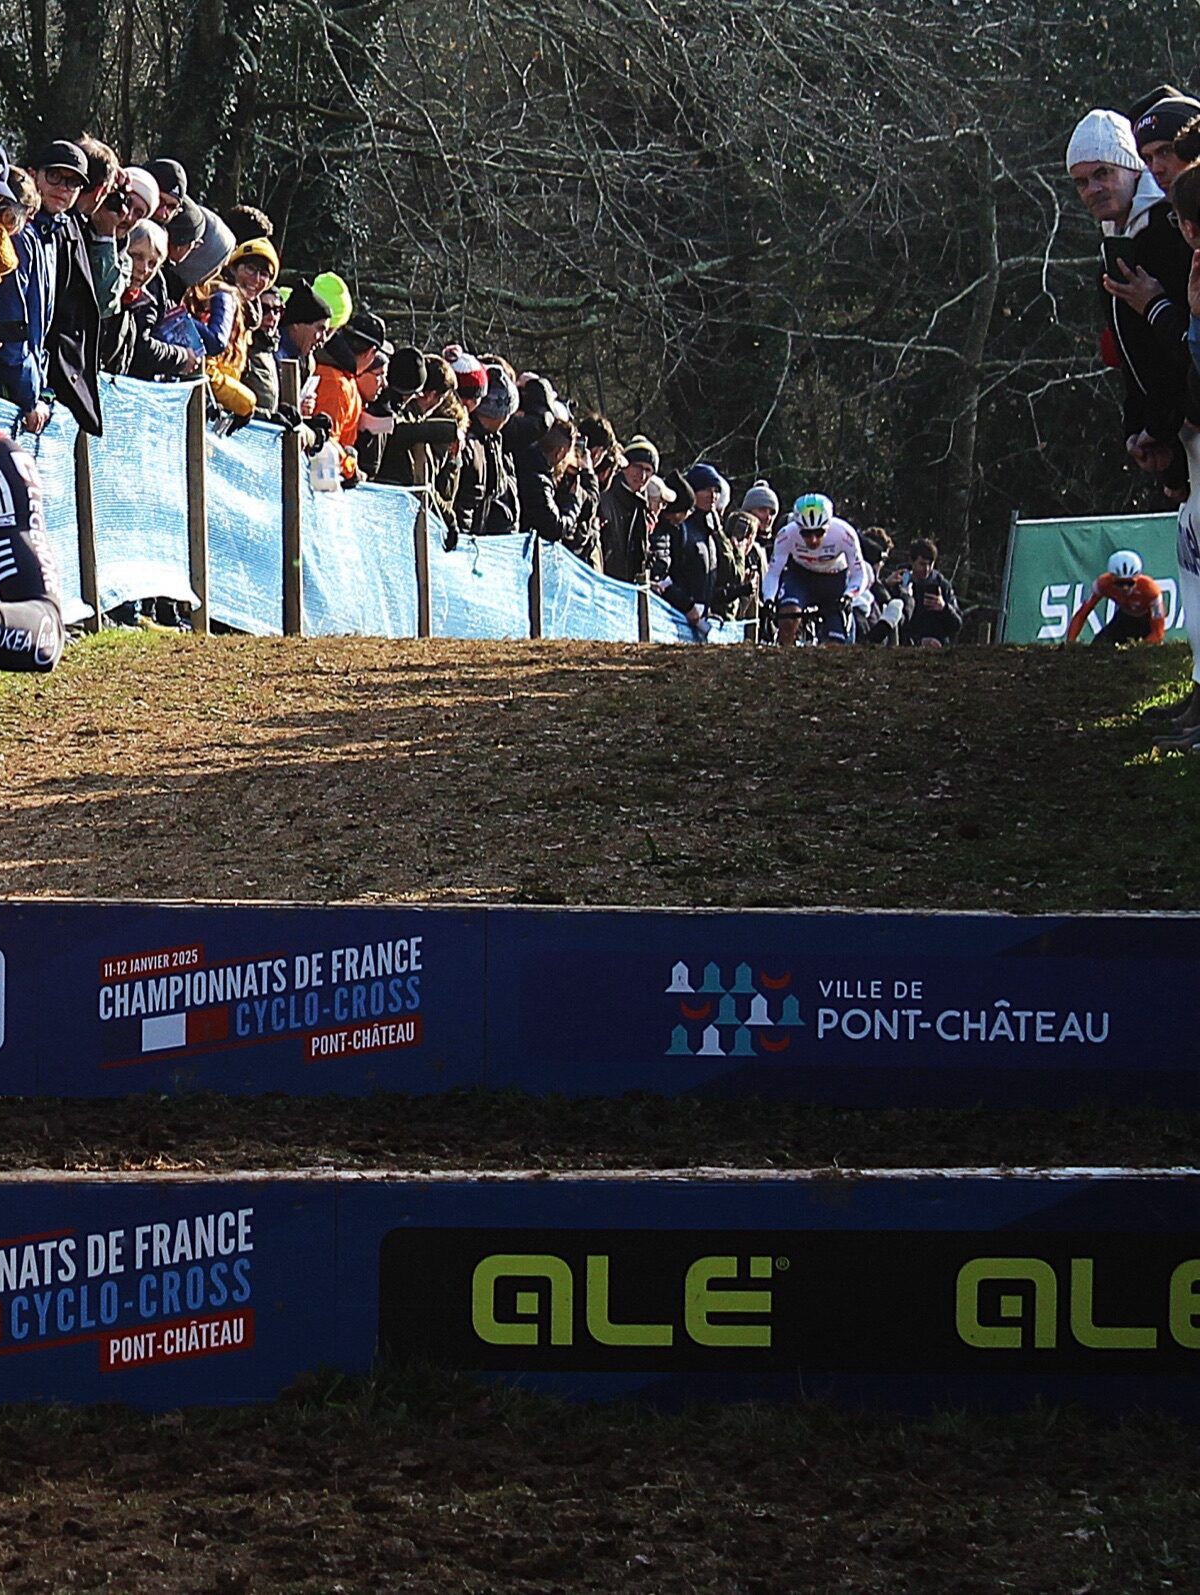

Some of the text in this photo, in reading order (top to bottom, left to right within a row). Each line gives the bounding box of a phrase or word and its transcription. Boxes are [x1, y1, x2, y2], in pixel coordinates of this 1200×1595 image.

[99, 936, 422, 1021] CHAMPIONNATS DE FRANCE
[104, 949, 198, 978] 11-12 JANVIER 2025
[819, 980, 923, 999] VILLE DE
[311, 1022, 415, 1057] PONT-CHÂTEAU
[817, 999, 1109, 1044] PONT-CHÂTEAU
[87, 1230, 124, 1278] DE
[135, 1207, 254, 1270] FRANCE
[109, 1317, 245, 1365] PONT-CHÂTEAU
